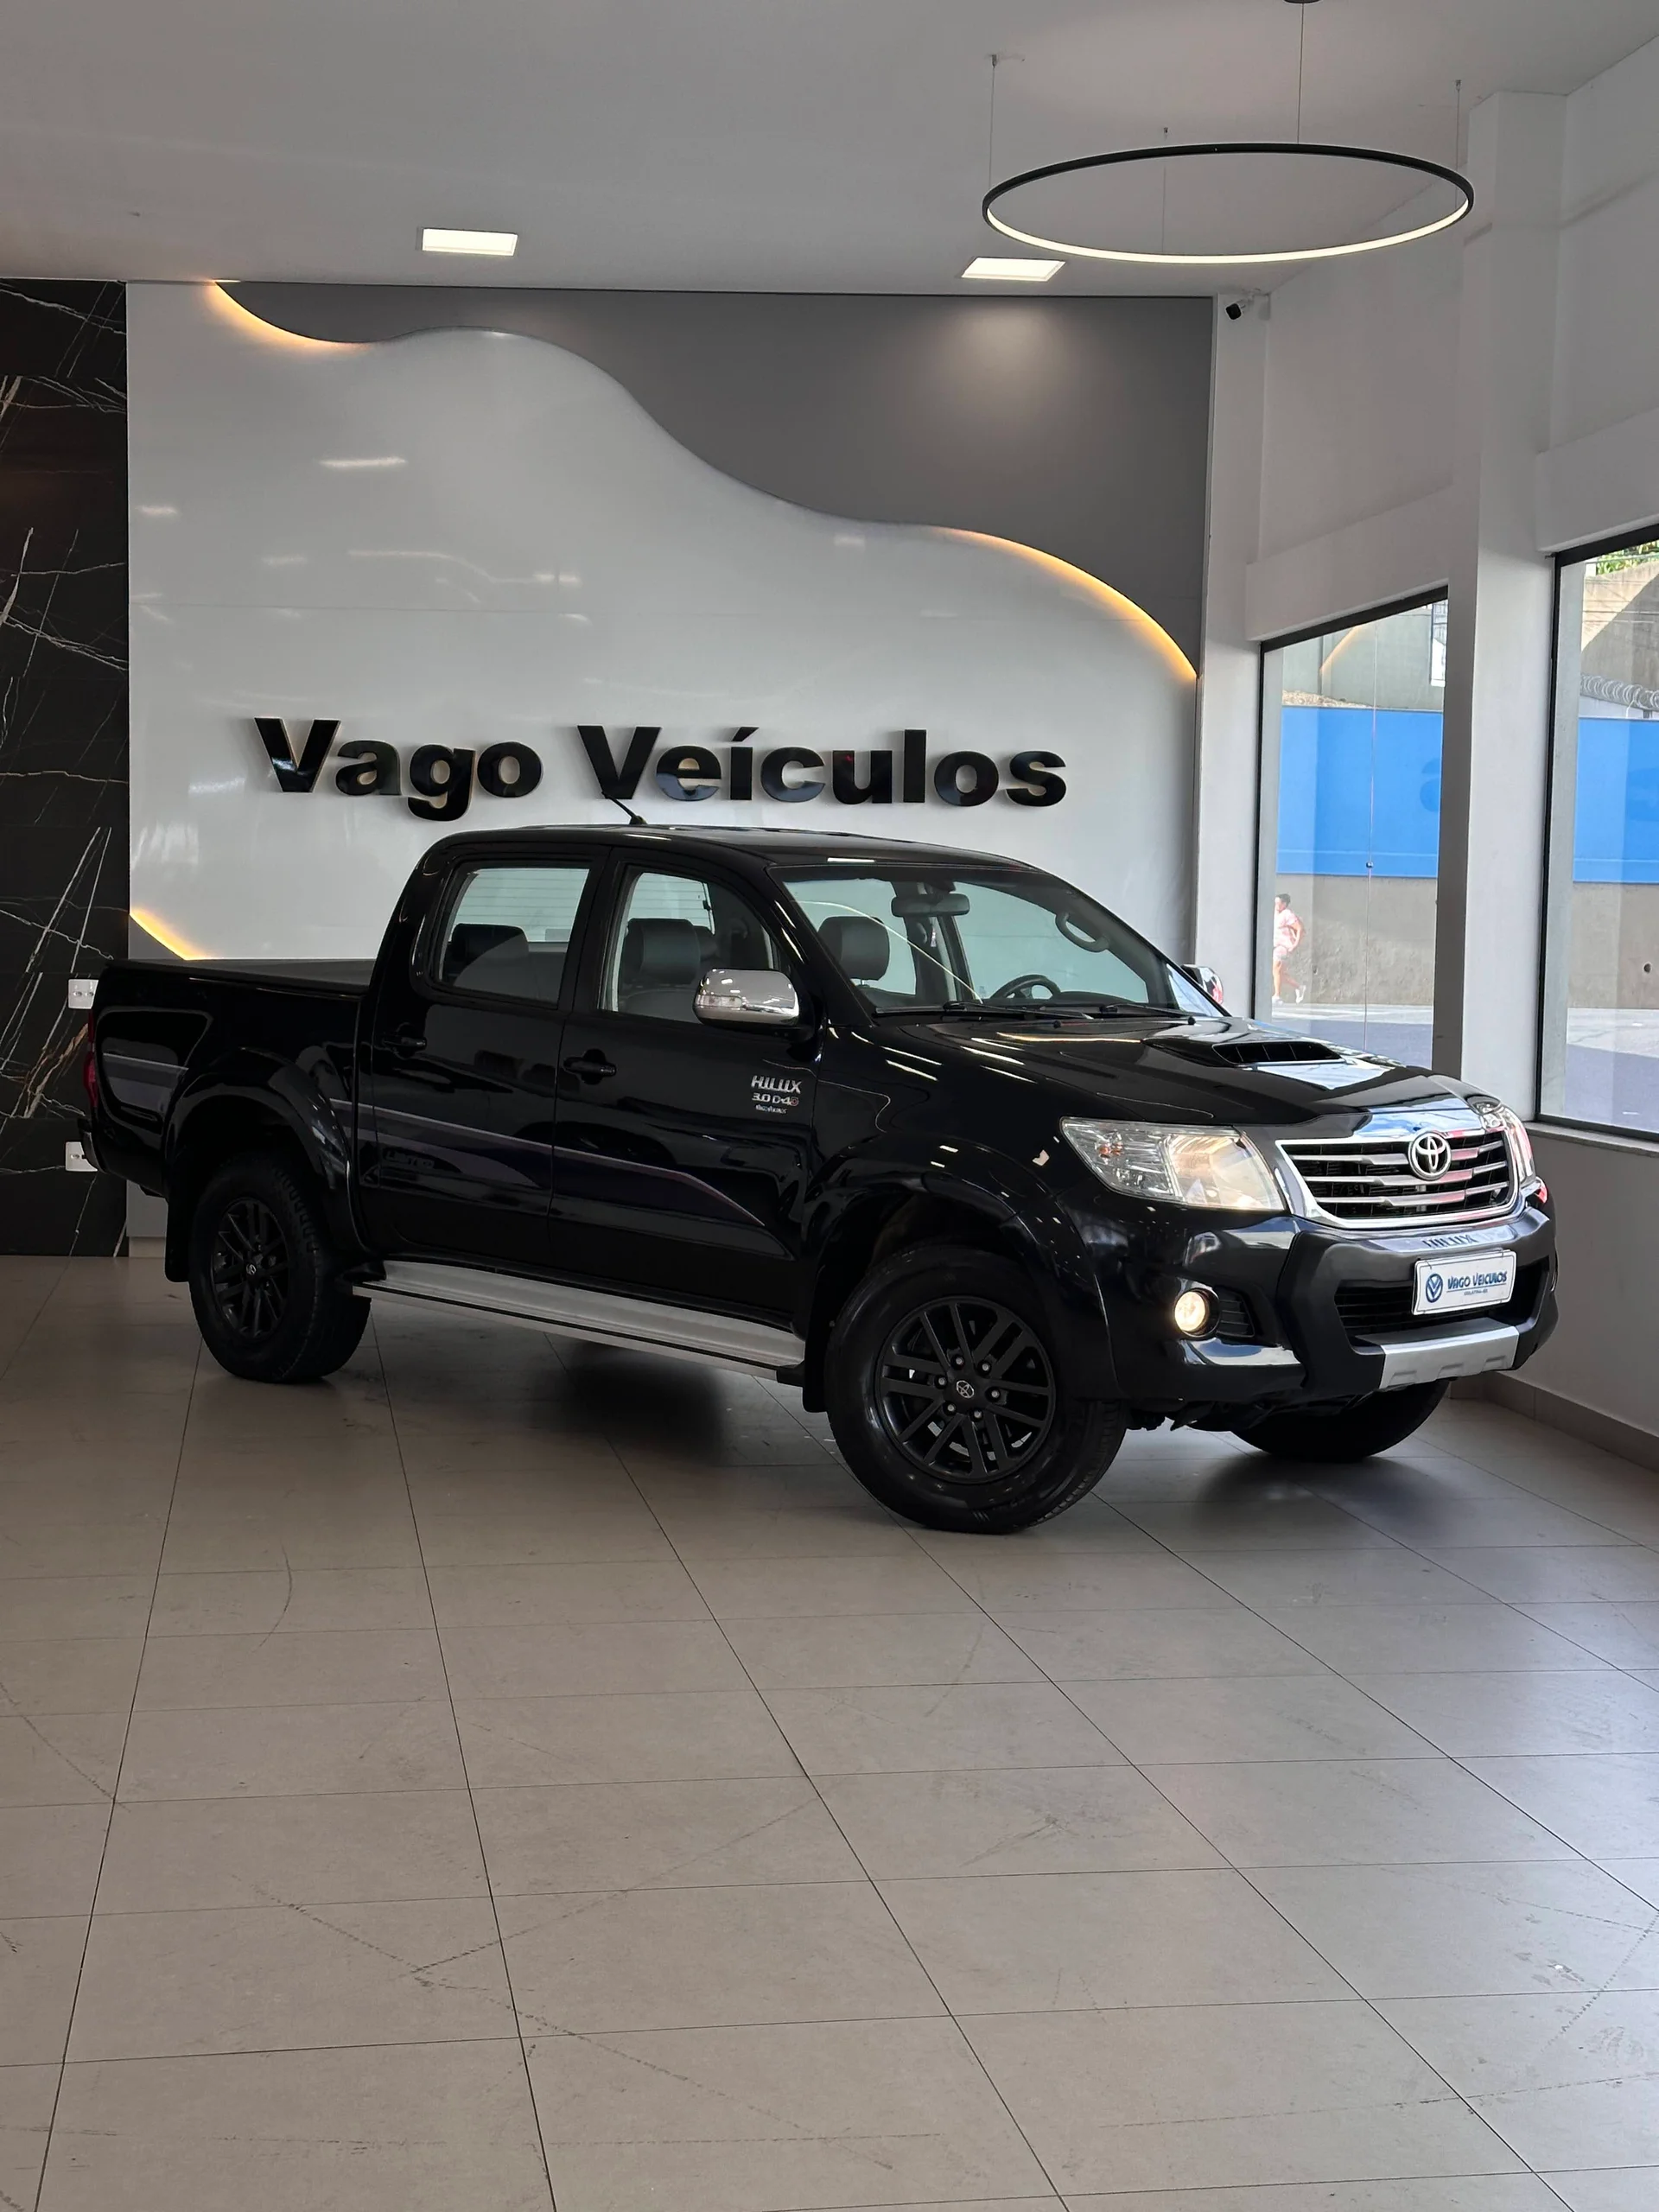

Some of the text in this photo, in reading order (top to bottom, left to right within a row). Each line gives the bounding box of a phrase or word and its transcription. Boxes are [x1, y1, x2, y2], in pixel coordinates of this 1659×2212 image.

[254, 717, 1067, 822] Vago Veículos
[751, 1075, 802, 1094] HILUX
[1447, 1275, 1471, 1289] VAGO
